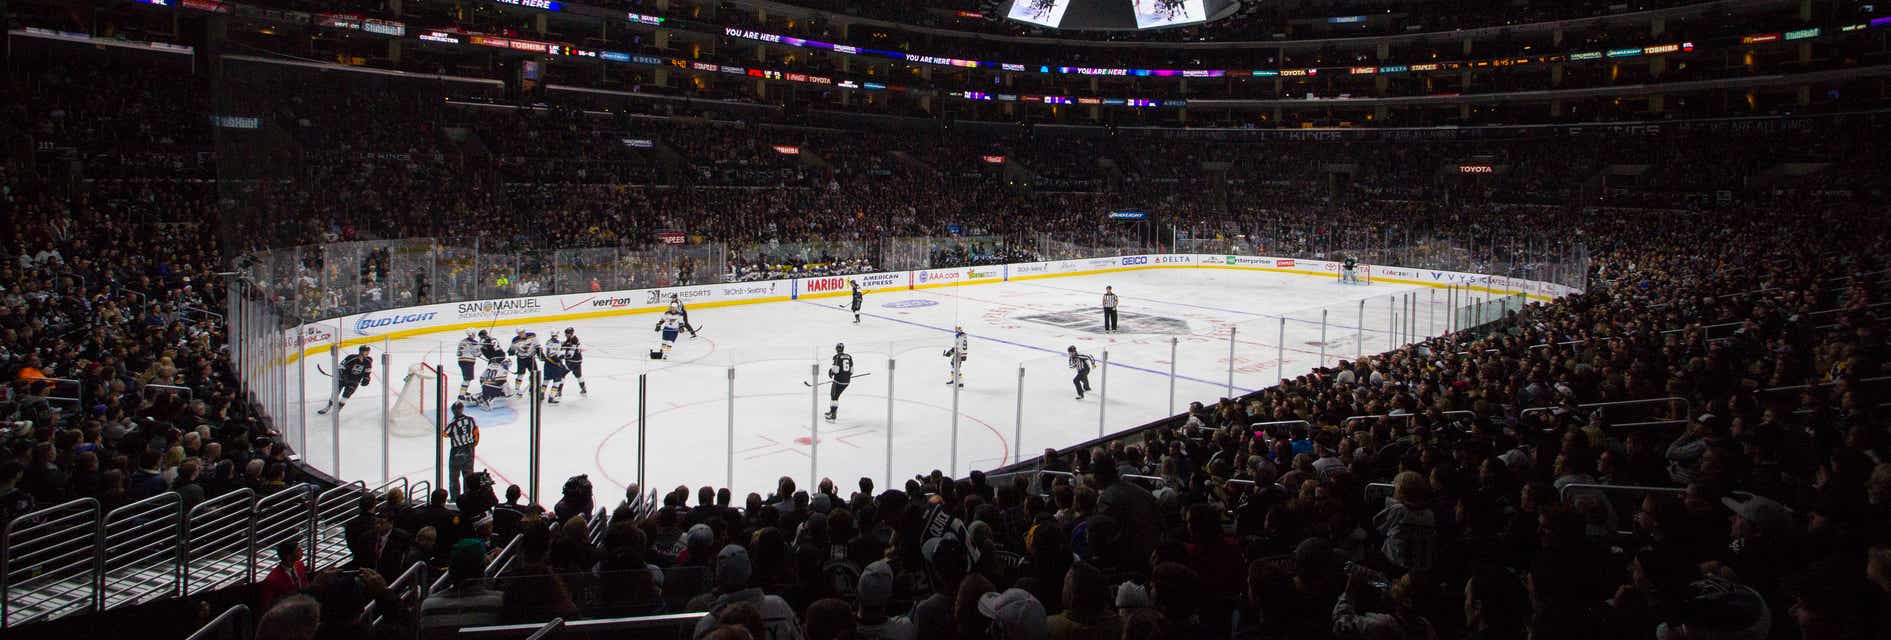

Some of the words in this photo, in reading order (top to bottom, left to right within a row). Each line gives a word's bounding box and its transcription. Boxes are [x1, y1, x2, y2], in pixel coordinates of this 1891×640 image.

[725, 27, 741, 37] YOU
[743, 31, 759, 41] ARE
[760, 32, 780, 43] HERE
[1644, 44, 1679, 54] TOSHIBA
[905, 53, 920, 63] YOU
[920, 55, 933, 65] ARE
[933, 57, 951, 66] HERE
[1077, 66, 1092, 74] YOU
[1092, 67, 1107, 75] ARE
[1107, 66, 1127, 76] HERE
[1280, 69, 1306, 78] TOYOTA
[808, 75, 832, 85] TOYOTA
[1459, 165, 1493, 173] TOYOTA
[1121, 256, 1148, 266] GEICO
[863, 274, 900, 282] AMERICAN
[929, 271, 960, 281] AAA.com
[807, 277, 845, 292] HARIBO
[862, 280, 894, 288] EXPRESS
[679, 289, 713, 299] RESORTS
[457, 302, 483, 315] SAN
[492, 298, 542, 311] MANUEL
[592, 296, 631, 308] verizon
[359, 317, 392, 331] BUD
[391, 311, 438, 325] LIGHT
[842, 358, 851, 372] 6
